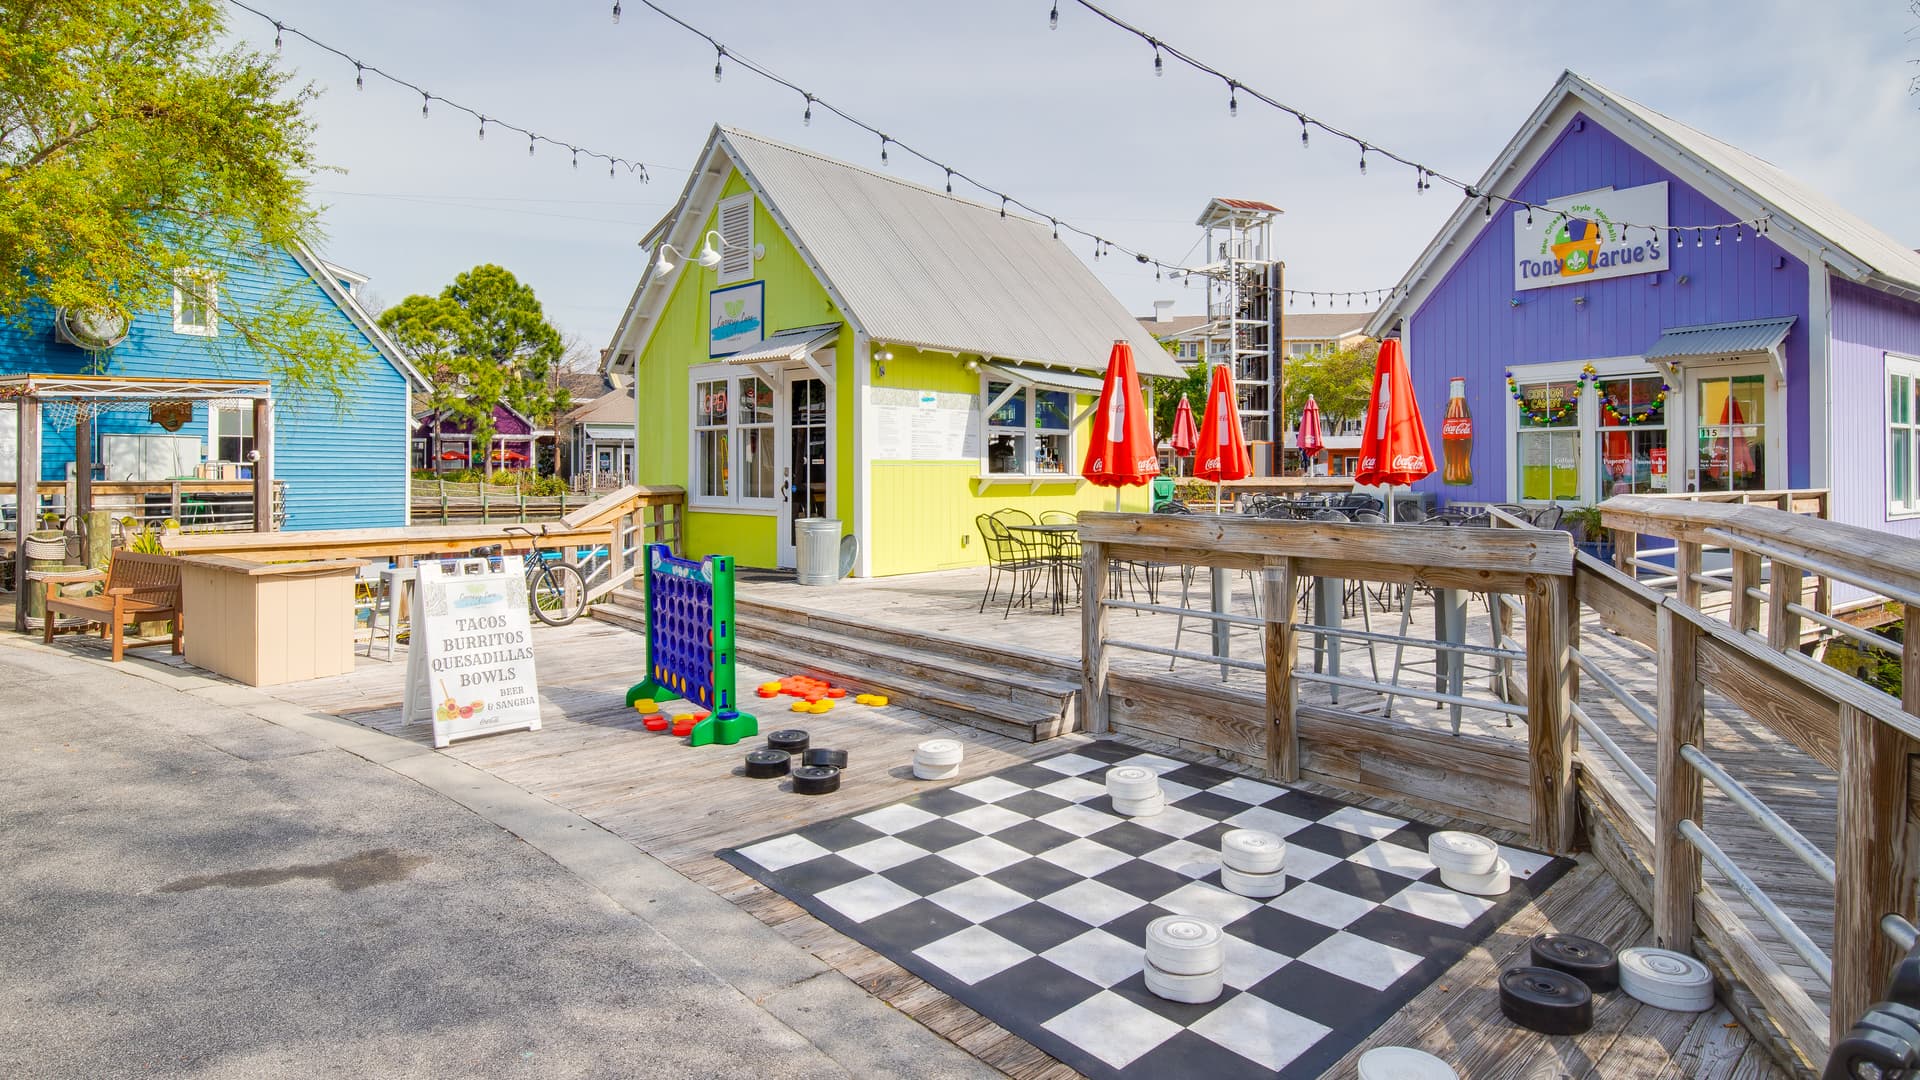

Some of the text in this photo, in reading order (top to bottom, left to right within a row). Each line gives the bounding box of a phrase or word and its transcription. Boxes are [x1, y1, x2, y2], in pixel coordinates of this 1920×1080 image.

[1571, 203, 1591, 213] Style
[1519, 240, 1661, 279] Tony Larue's
[1528, 387, 1564, 400] COTTON
[1530, 397, 1561, 410] CANDY
[1701, 429, 1718, 437] 115
[1603, 458, 1631, 467] Popcorn
[455, 615, 507, 632] TACOS
[443, 631, 524, 652] BURRITOS
[432, 647, 534, 672] QUESADILLAS
[460, 667, 517, 687] BOWLS
[500, 686, 524, 697] BEER
[487, 696, 536, 711] & SANGRIA
